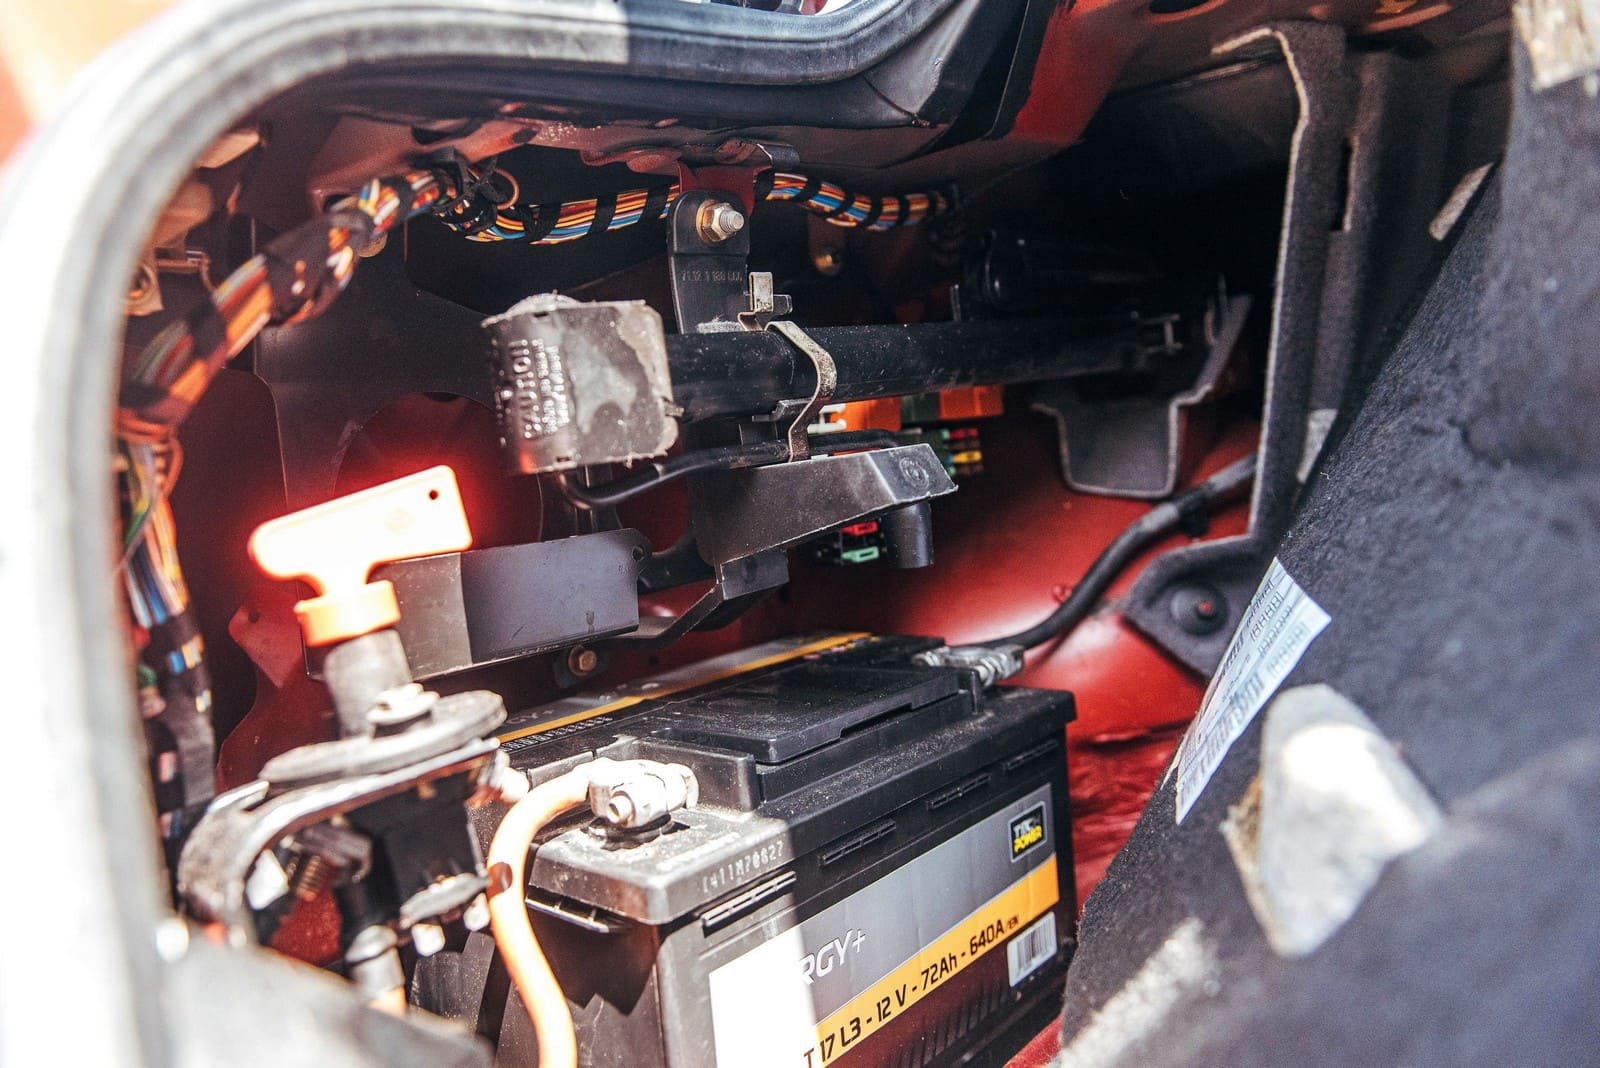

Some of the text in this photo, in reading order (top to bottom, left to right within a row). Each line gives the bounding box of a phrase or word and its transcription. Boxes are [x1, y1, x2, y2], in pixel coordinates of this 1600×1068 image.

[820, 1033, 835, 1062] 17
[840, 1017, 861, 1048] L3
[876, 996, 892, 1022] 12
[895, 984, 907, 1007] V
[921, 952, 958, 991] 72Ah
[969, 919, 1005, 956] 640A
